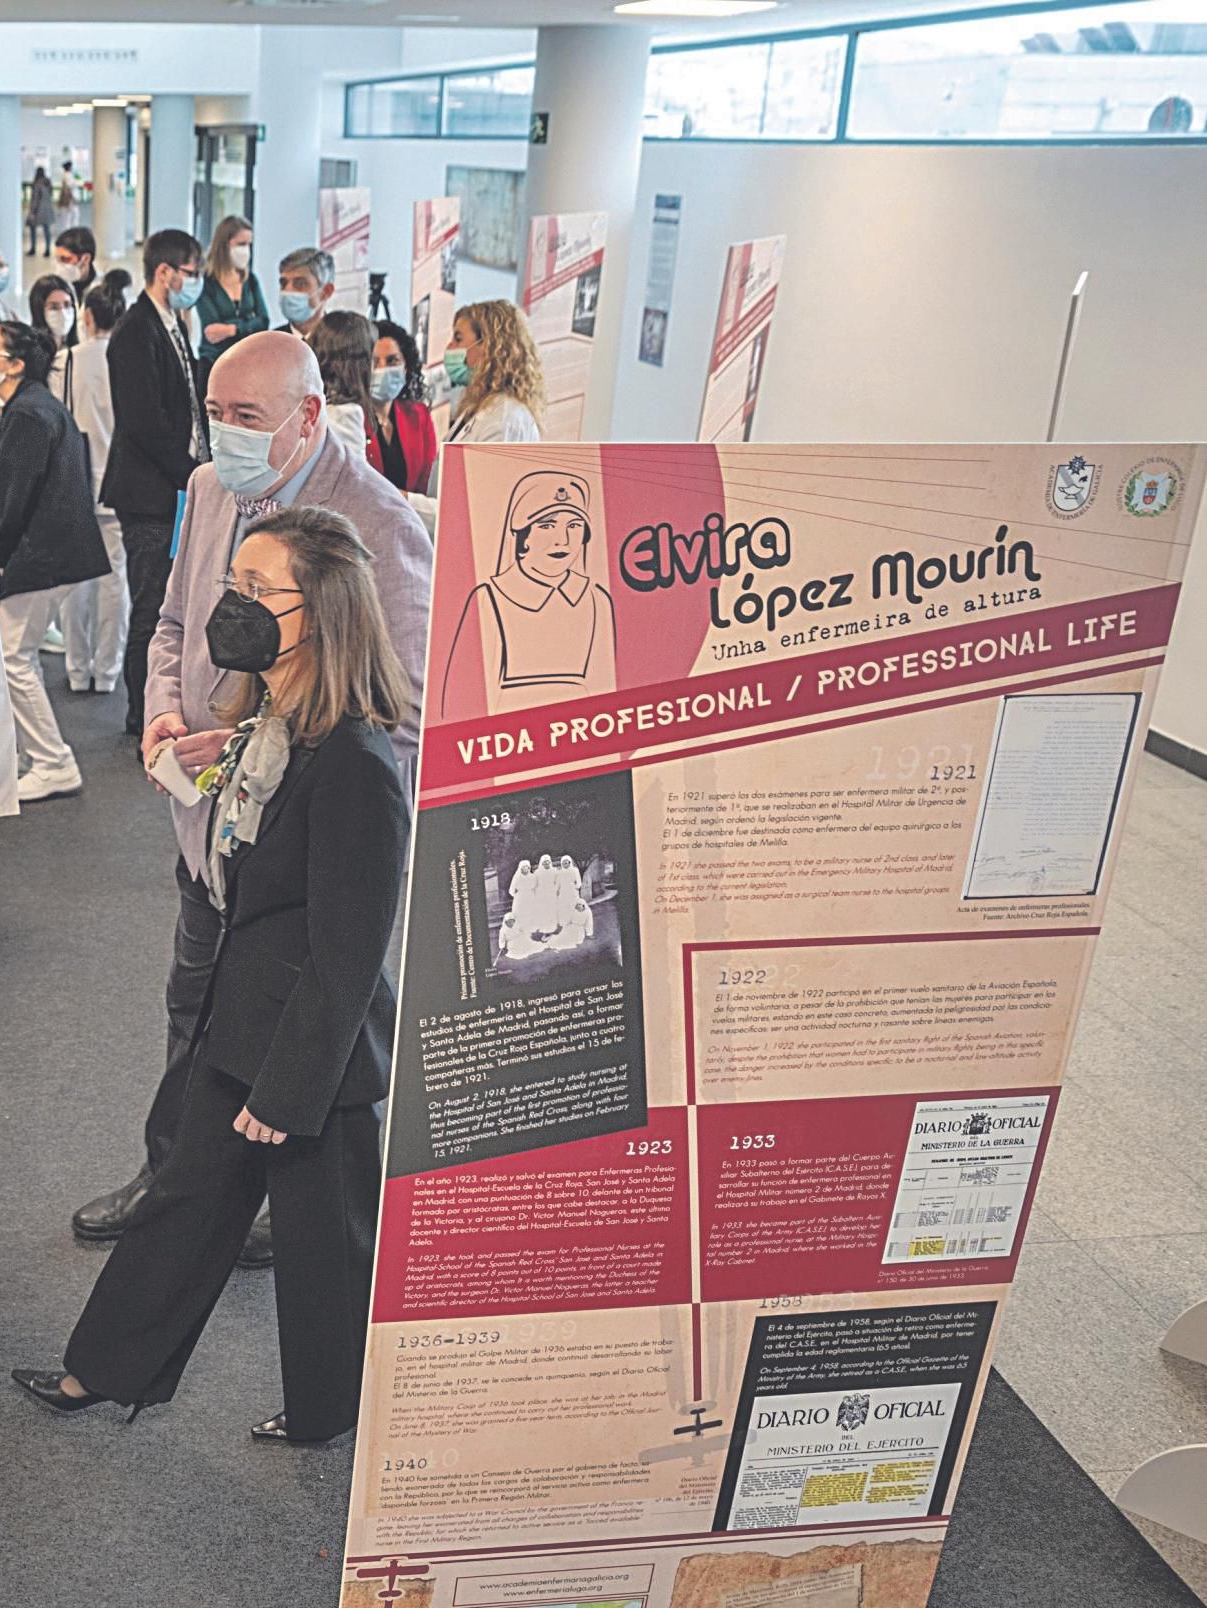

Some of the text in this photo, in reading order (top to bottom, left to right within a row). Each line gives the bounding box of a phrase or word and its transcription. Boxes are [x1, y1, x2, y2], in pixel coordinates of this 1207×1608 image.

[619, 513, 791, 592] Elvira
[709, 524, 1041, 631] López Mourín
[711, 585, 1042, 661] Unha enfermeira de altura
[457, 610, 1137, 764] VIDA PROFESIONAL / PROFESSIONAL LIFE
[930, 765, 976, 781] 1921
[471, 813, 511, 831] 1918
[718, 969, 767, 985] 1922
[419, 1019, 427, 1028] El
[430, 1016, 437, 1026] 2
[439, 1015, 451, 1024] de
[453, 1009, 482, 1022] agosto
[484, 1006, 496, 1015] de
[527, 992, 558, 1007] ingresó
[560, 989, 582, 1001] para
[583, 984, 608, 995] cursar
[611, 980, 624, 989] los
[420, 991, 624, 1039] estudios de enfermería en el Hospital de San José
[426, 1072, 490, 1092] brero de 1921.
[914, 1116, 1041, 1135] DIARIO OFICIAL
[626, 1140, 673, 1156] 1923
[730, 1135, 776, 1150] 1933
[921, 1137, 1025, 1151] MINISTERIO DE LA GUERRA
[408, 1238, 434, 1247] Adela.
[397, 1331, 500, 1348] 1936-1939
[757, 1400, 945, 1429] DIARIO OFICIAL
[767, 1437, 924, 1456] MINISTERIO DEL EJERCITO
[384, 1458, 428, 1472] 1940
